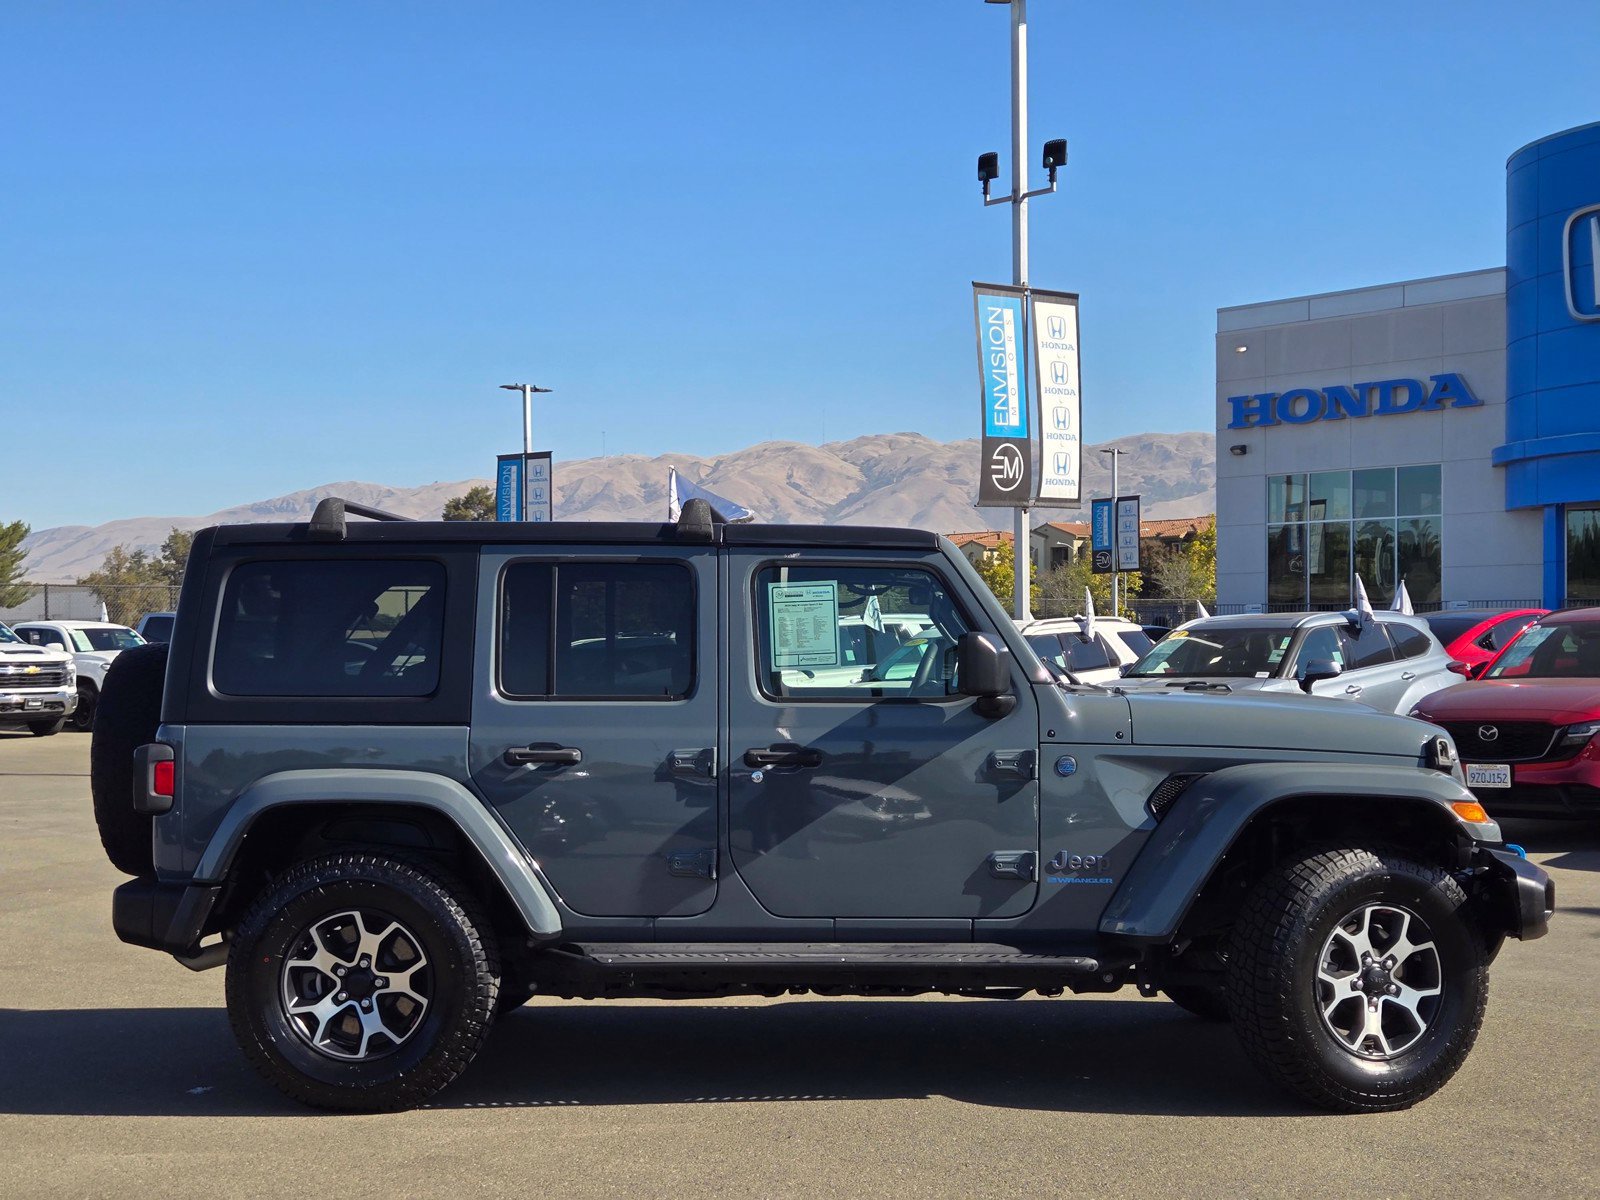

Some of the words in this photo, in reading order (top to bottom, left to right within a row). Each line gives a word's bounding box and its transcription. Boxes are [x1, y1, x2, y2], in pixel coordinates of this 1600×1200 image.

[1041, 341, 1075, 351] HONDA
[987, 306, 1009, 426] ENVISION
[1006, 319, 1017, 416] MOTORS
[1044, 387, 1076, 396] HONDA
[1227, 372, 1484, 429] HONDA
[1046, 432, 1077, 441] HONDA
[1045, 478, 1077, 487] HONDA
[1052, 849, 1111, 874] Jeep
